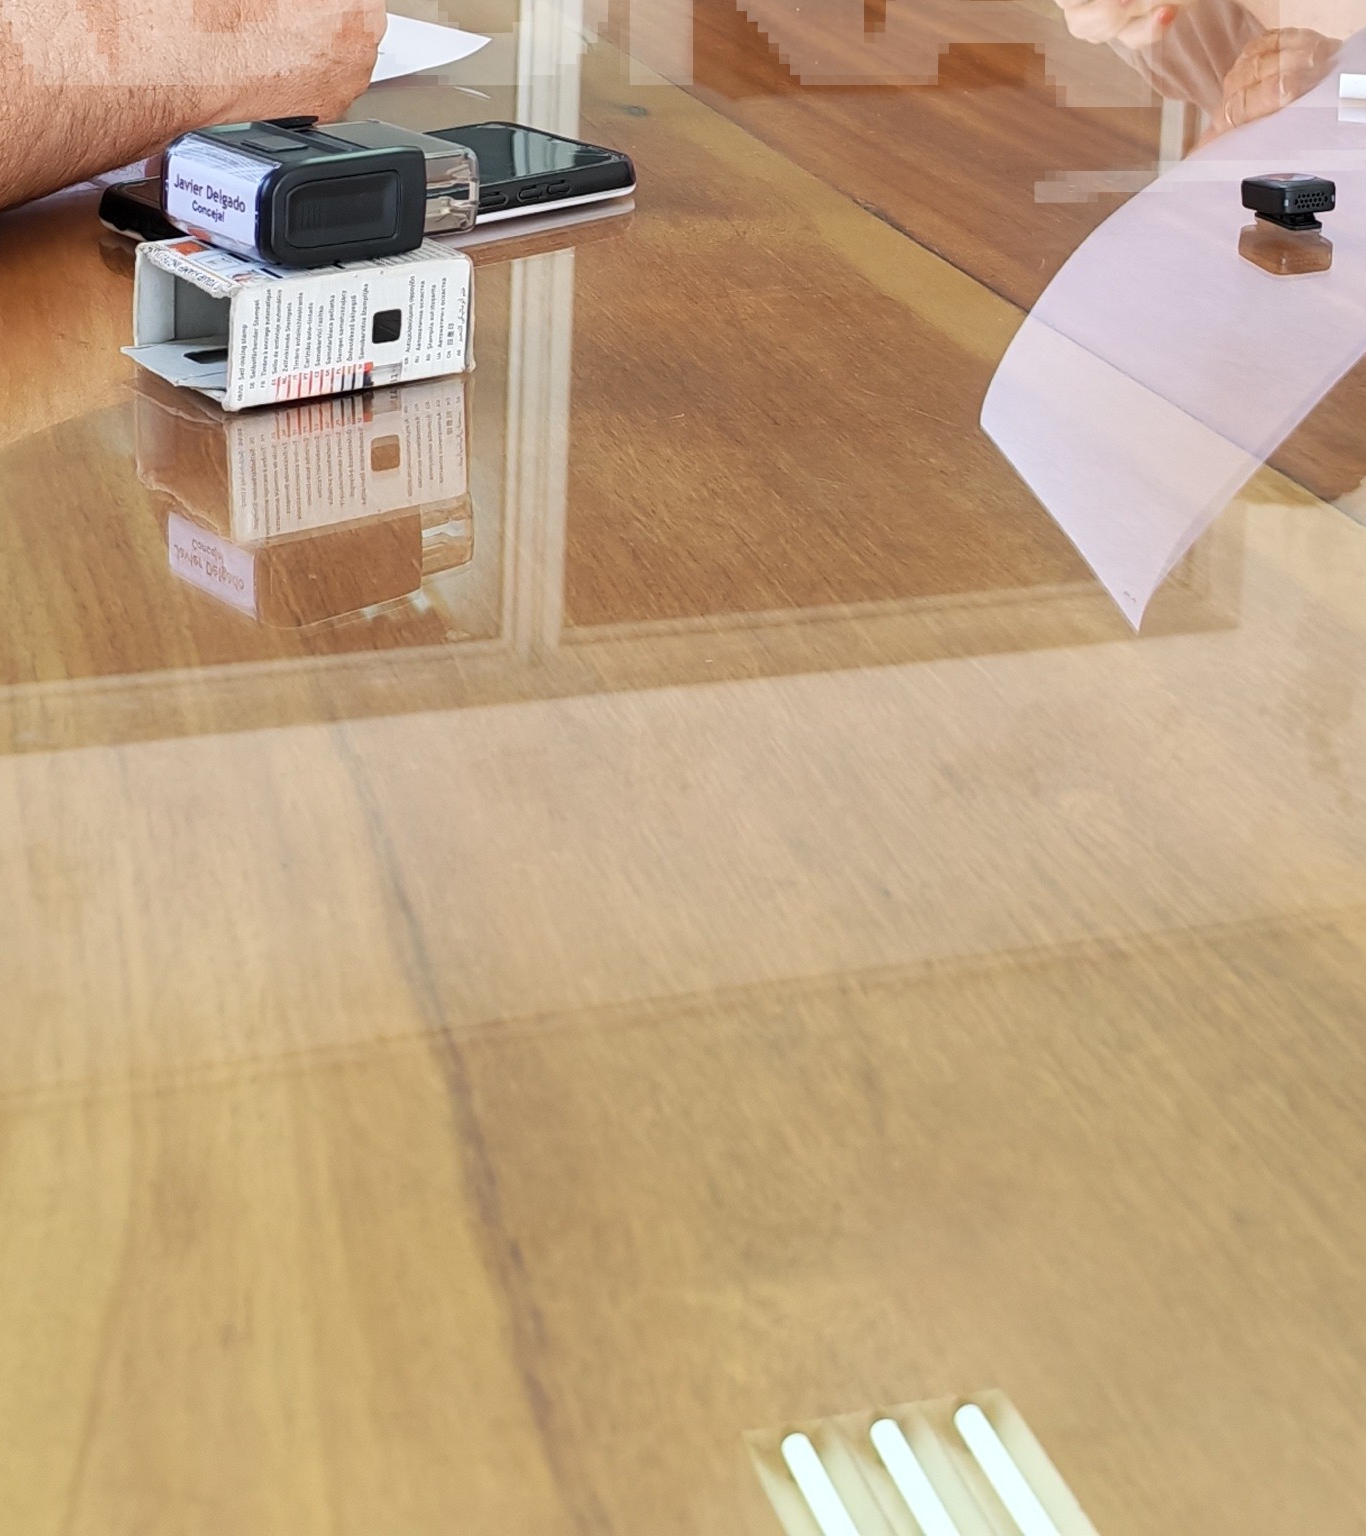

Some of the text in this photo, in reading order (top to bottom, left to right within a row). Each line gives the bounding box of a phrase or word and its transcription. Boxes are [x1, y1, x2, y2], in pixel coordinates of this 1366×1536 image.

[174, 173, 246, 213] Javier Delgado
[191, 200, 225, 223] Concejal
